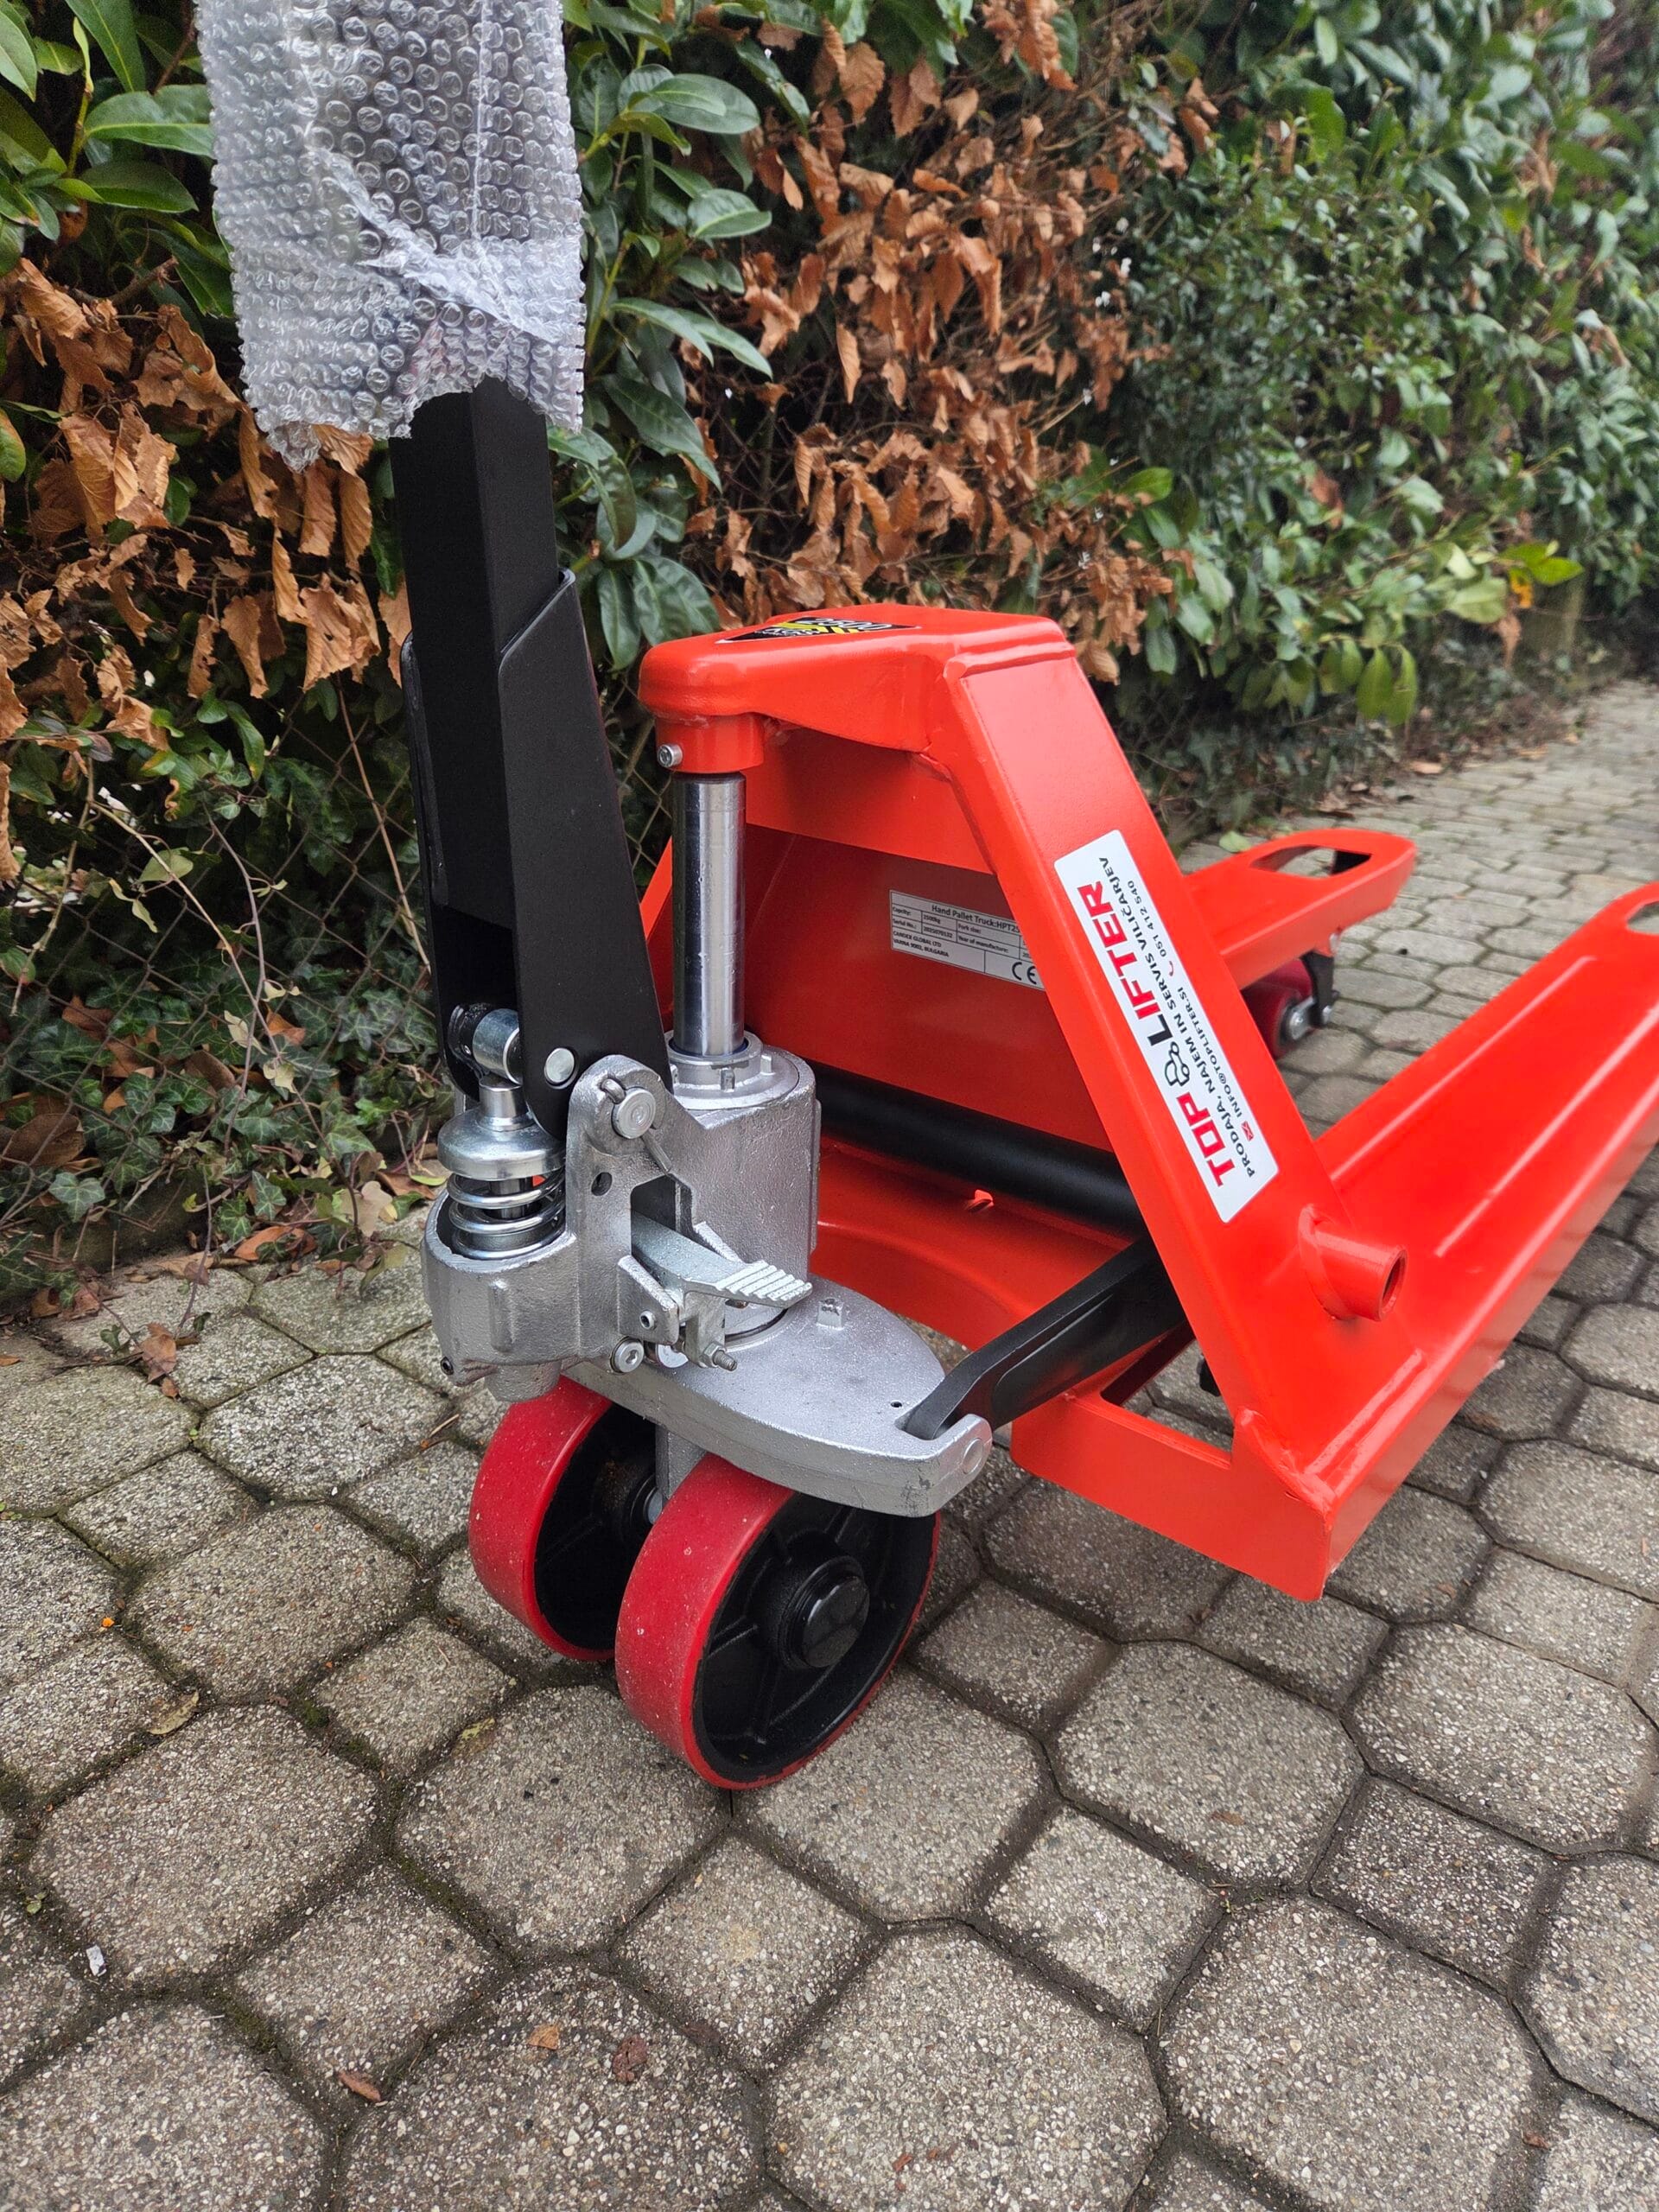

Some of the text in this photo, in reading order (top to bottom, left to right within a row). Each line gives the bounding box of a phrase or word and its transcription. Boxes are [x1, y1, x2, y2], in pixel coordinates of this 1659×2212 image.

[923, 946, 948, 957] BULGARIA
[931, 906, 951, 916] Hand
[952, 910, 974, 922] Pallet
[1127, 880, 1167, 957] 051 412 540
[1077, 880, 1236, 1187] TOP LIFTER
[1098, 857, 1255, 1177] PRODAJA, NAJEM IN SERVIS VILIČARJEV
[1177, 987, 1243, 1118] INFO@TOPLIFTER.SI
